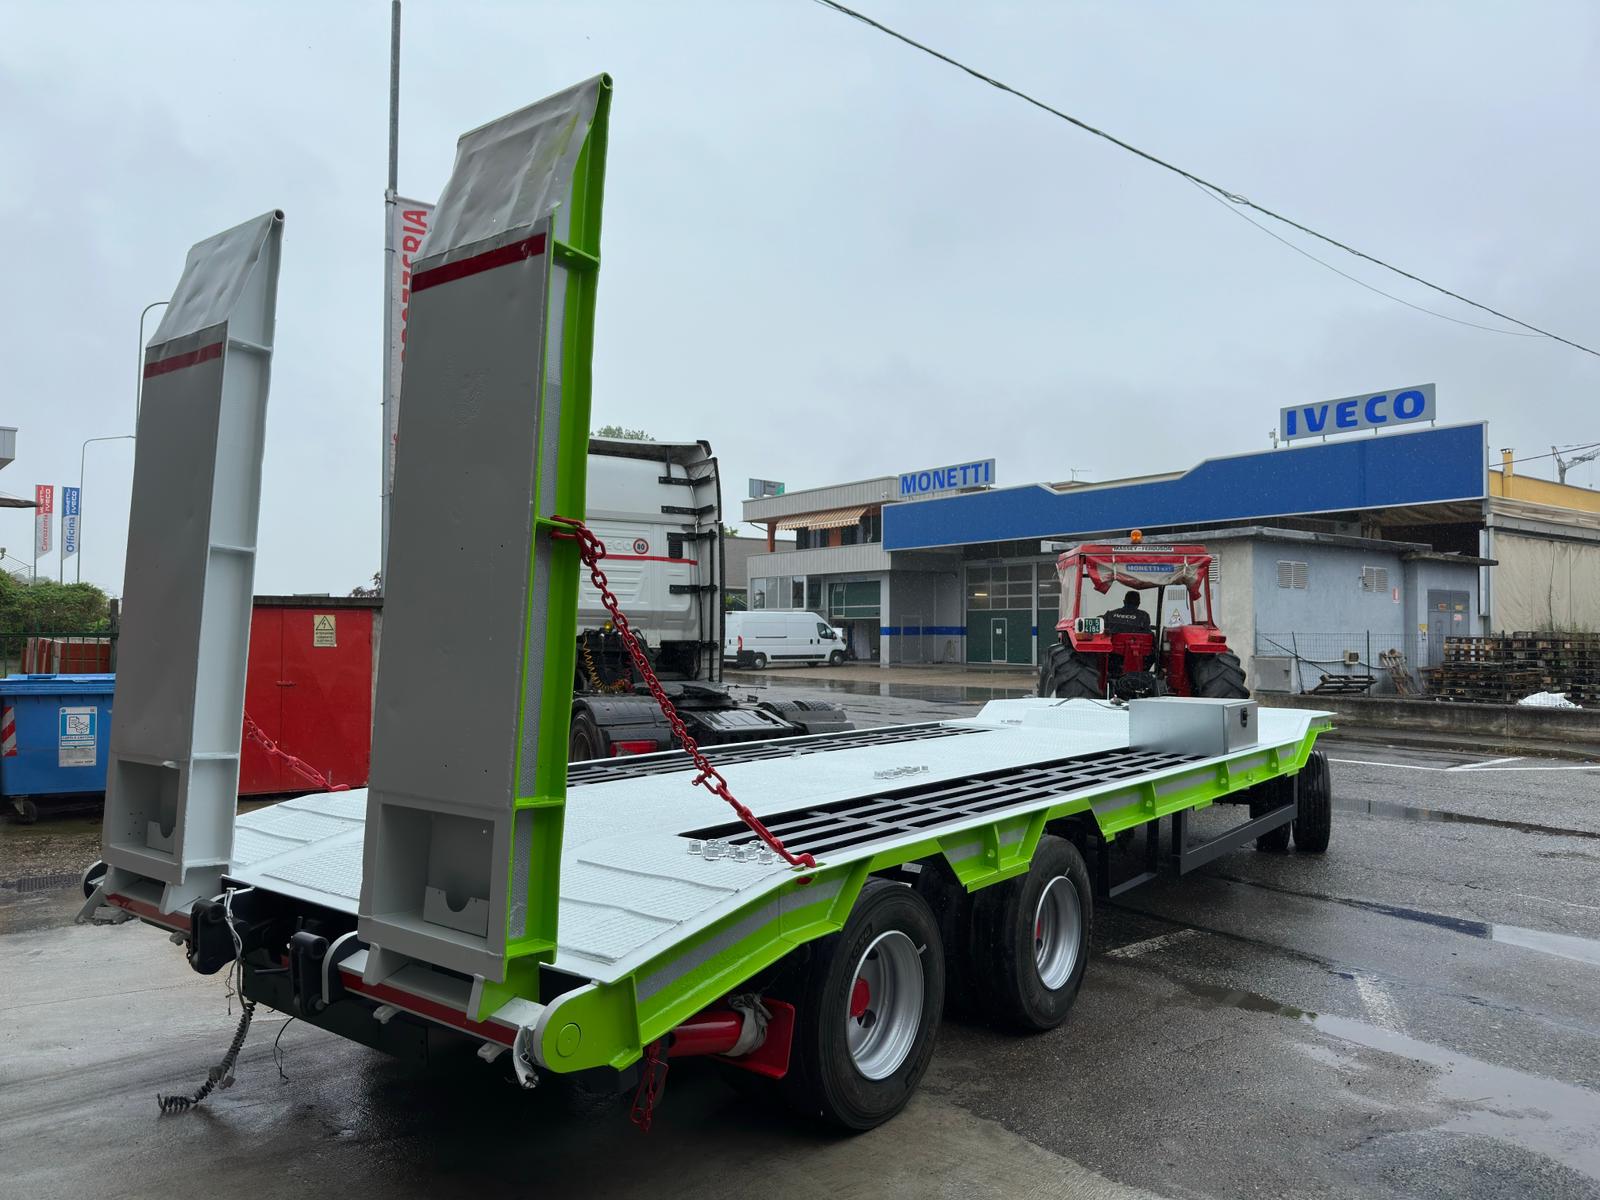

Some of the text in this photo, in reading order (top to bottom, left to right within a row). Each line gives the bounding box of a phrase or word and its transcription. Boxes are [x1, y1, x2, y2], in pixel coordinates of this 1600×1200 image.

[1286, 390, 1426, 436] IVECO
[901, 462, 990, 495] MONETTI
[66, 516, 75, 552] Officina
